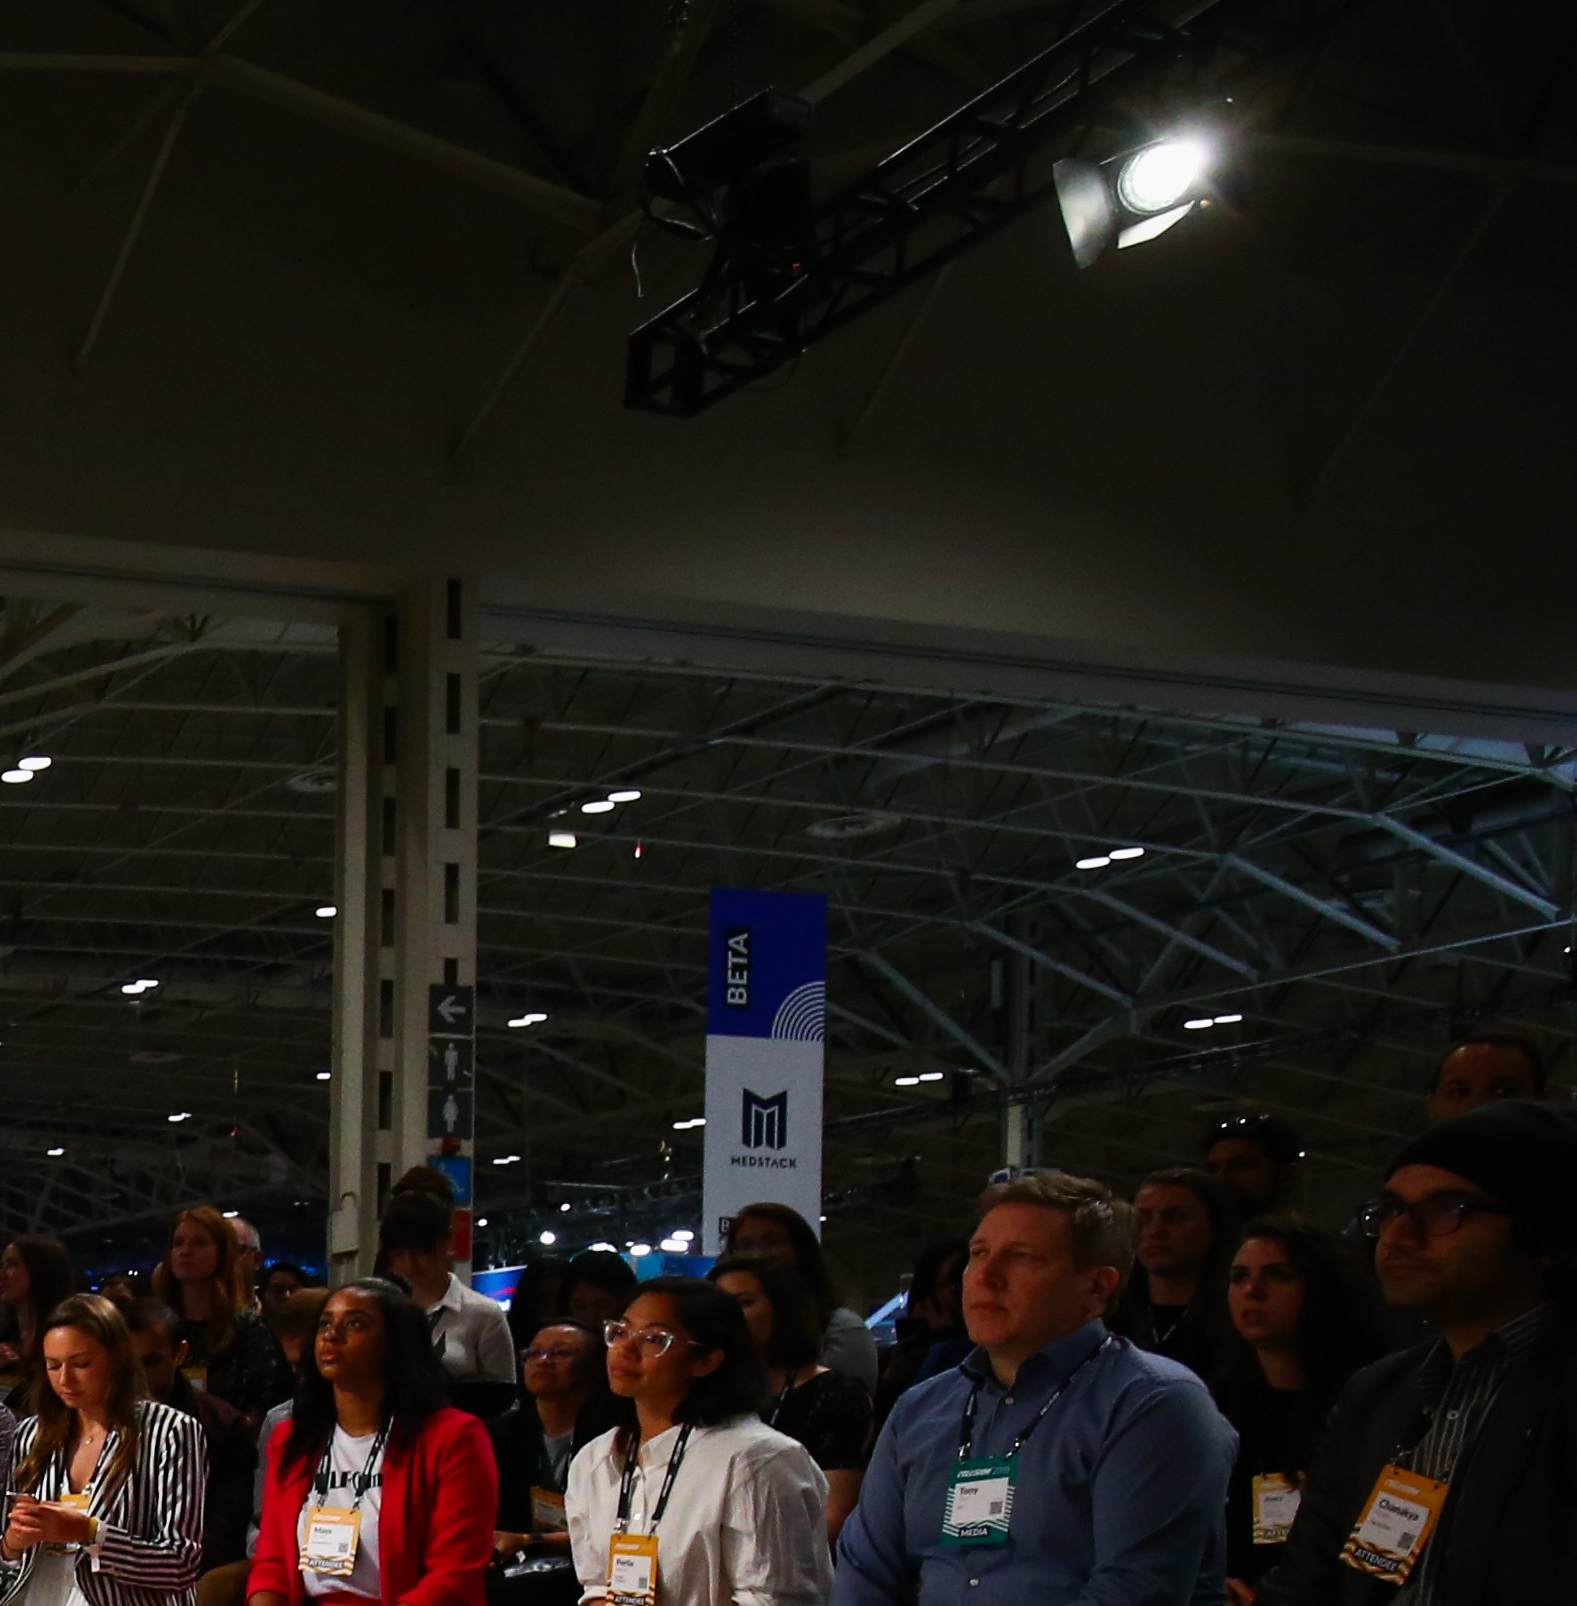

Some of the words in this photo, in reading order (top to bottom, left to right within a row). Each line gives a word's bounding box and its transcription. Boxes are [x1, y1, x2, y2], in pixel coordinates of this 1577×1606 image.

[726, 932, 749, 1005] BETA
[731, 1156, 797, 1169] MEDSTACK
[960, 1527, 988, 1537] MEDIA
[1354, 1548, 1399, 1572] ATTENDEE
